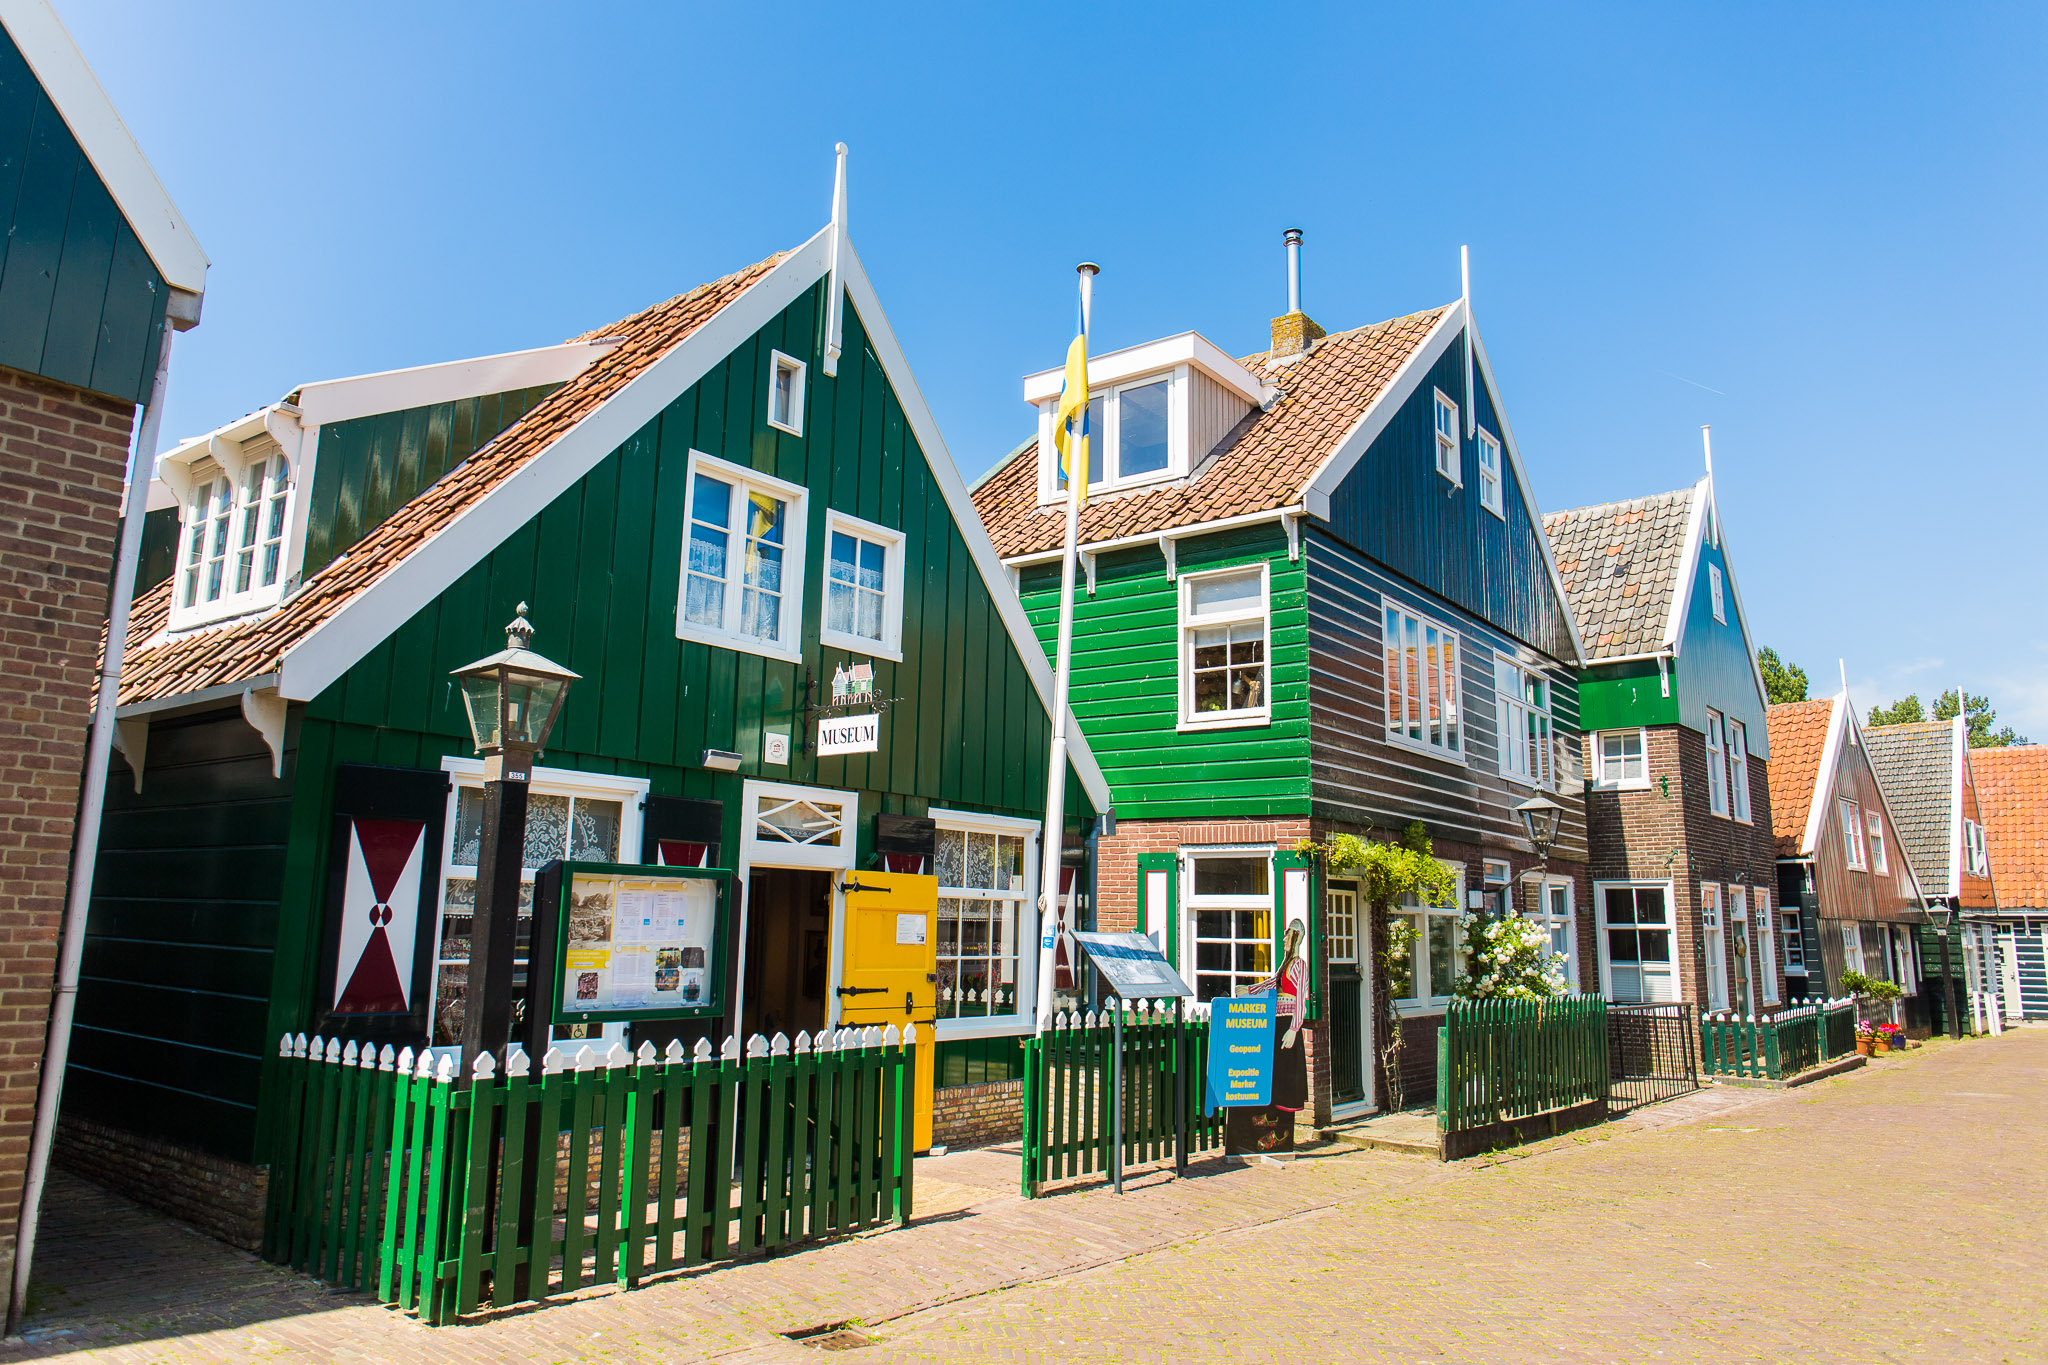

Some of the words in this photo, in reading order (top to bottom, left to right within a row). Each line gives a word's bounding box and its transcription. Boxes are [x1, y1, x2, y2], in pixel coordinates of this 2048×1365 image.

[821, 725, 875, 746] MUSEUM
[1228, 1003, 1266, 1013] MARKER
[1225, 1018, 1267, 1028] MUSEUM
[1229, 1044, 1261, 1054] Geopend
[1228, 1068, 1259, 1078] Expositie
[1230, 1079, 1256, 1088] Marker
[1225, 1091, 1259, 1101] kostuums
